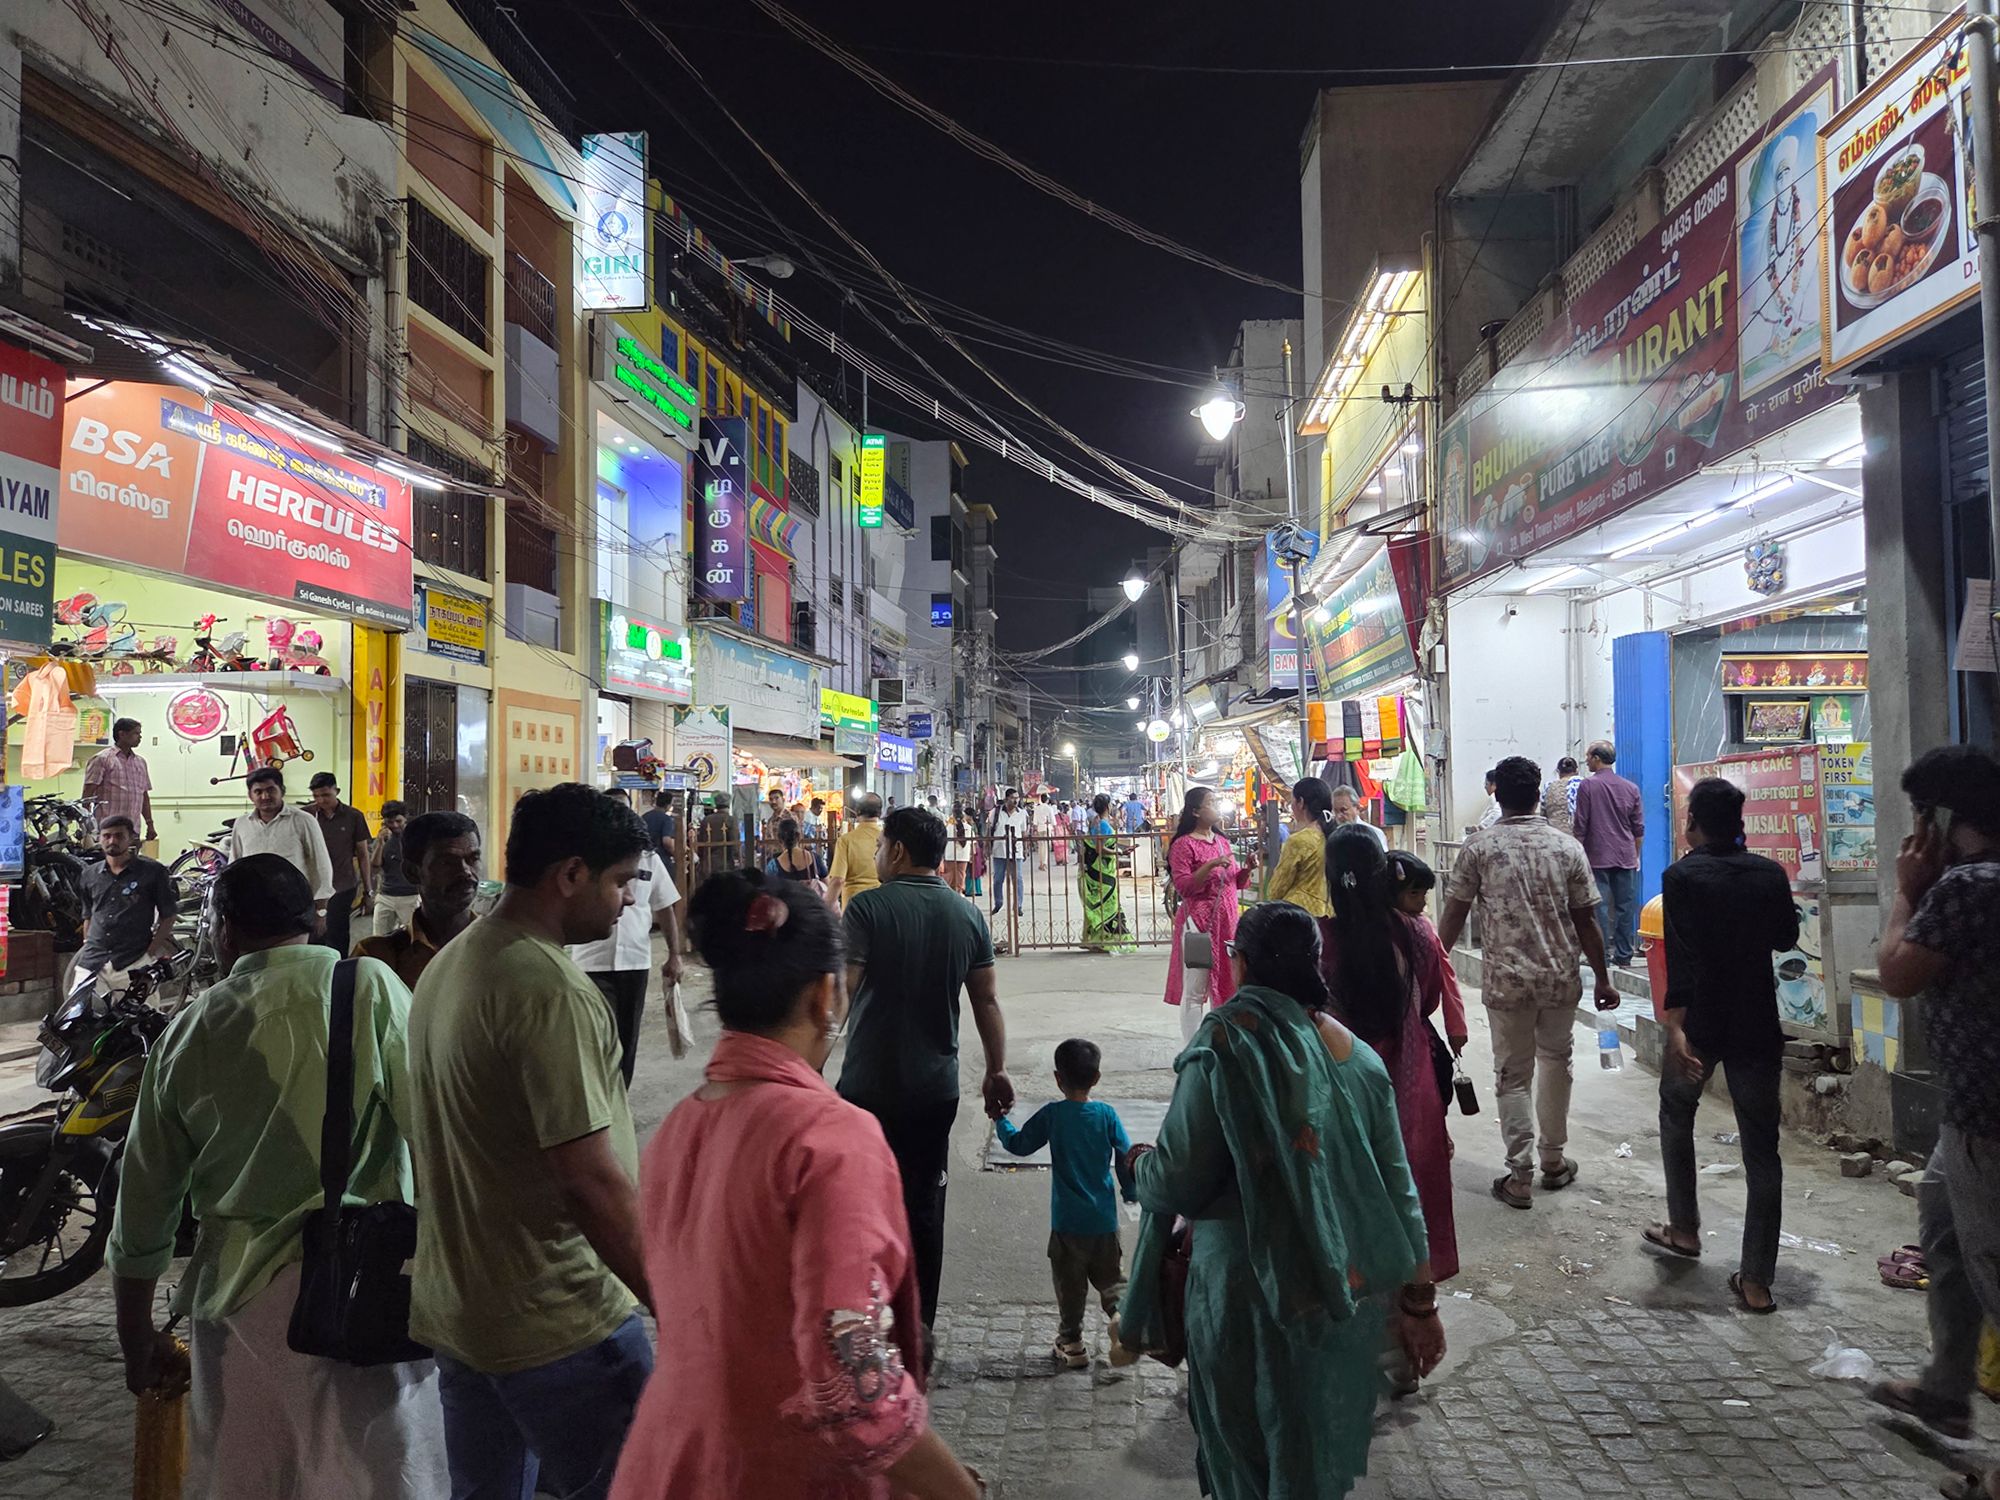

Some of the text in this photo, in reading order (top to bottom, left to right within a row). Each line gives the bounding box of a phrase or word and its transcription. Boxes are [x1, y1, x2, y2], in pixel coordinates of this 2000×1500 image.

[251, 19, 292, 58] CYCLES
[1661, 175, 1728, 254] 94435 02809
[584, 255, 640, 275] GIRI
[1768, 387, 1791, 411] राज
[70, 416, 174, 479] BSA
[703, 437, 739, 466] V.
[865, 438, 883, 446] ATM
[1540, 439, 1610, 502] PURE VEG
[1611, 478, 1626, 501] 625
[227, 469, 400, 553] HERCULES
[14, 599, 45, 617] SAREES
[300, 589, 351, 610] Sri Ganesh Cycles
[369, 667, 384, 796] AVON
[1827, 743, 1847, 755] BUY
[1762, 756, 1793, 772] CAKE
[1821, 758, 1854, 769] TOKEN
[1824, 772, 1853, 783] FIRST
[1750, 785, 1800, 801] மசாலா
[1743, 814, 1817, 834] MASALA TA
[1777, 847, 1797, 863] चाय
[1862, 859, 1877, 868] WA
